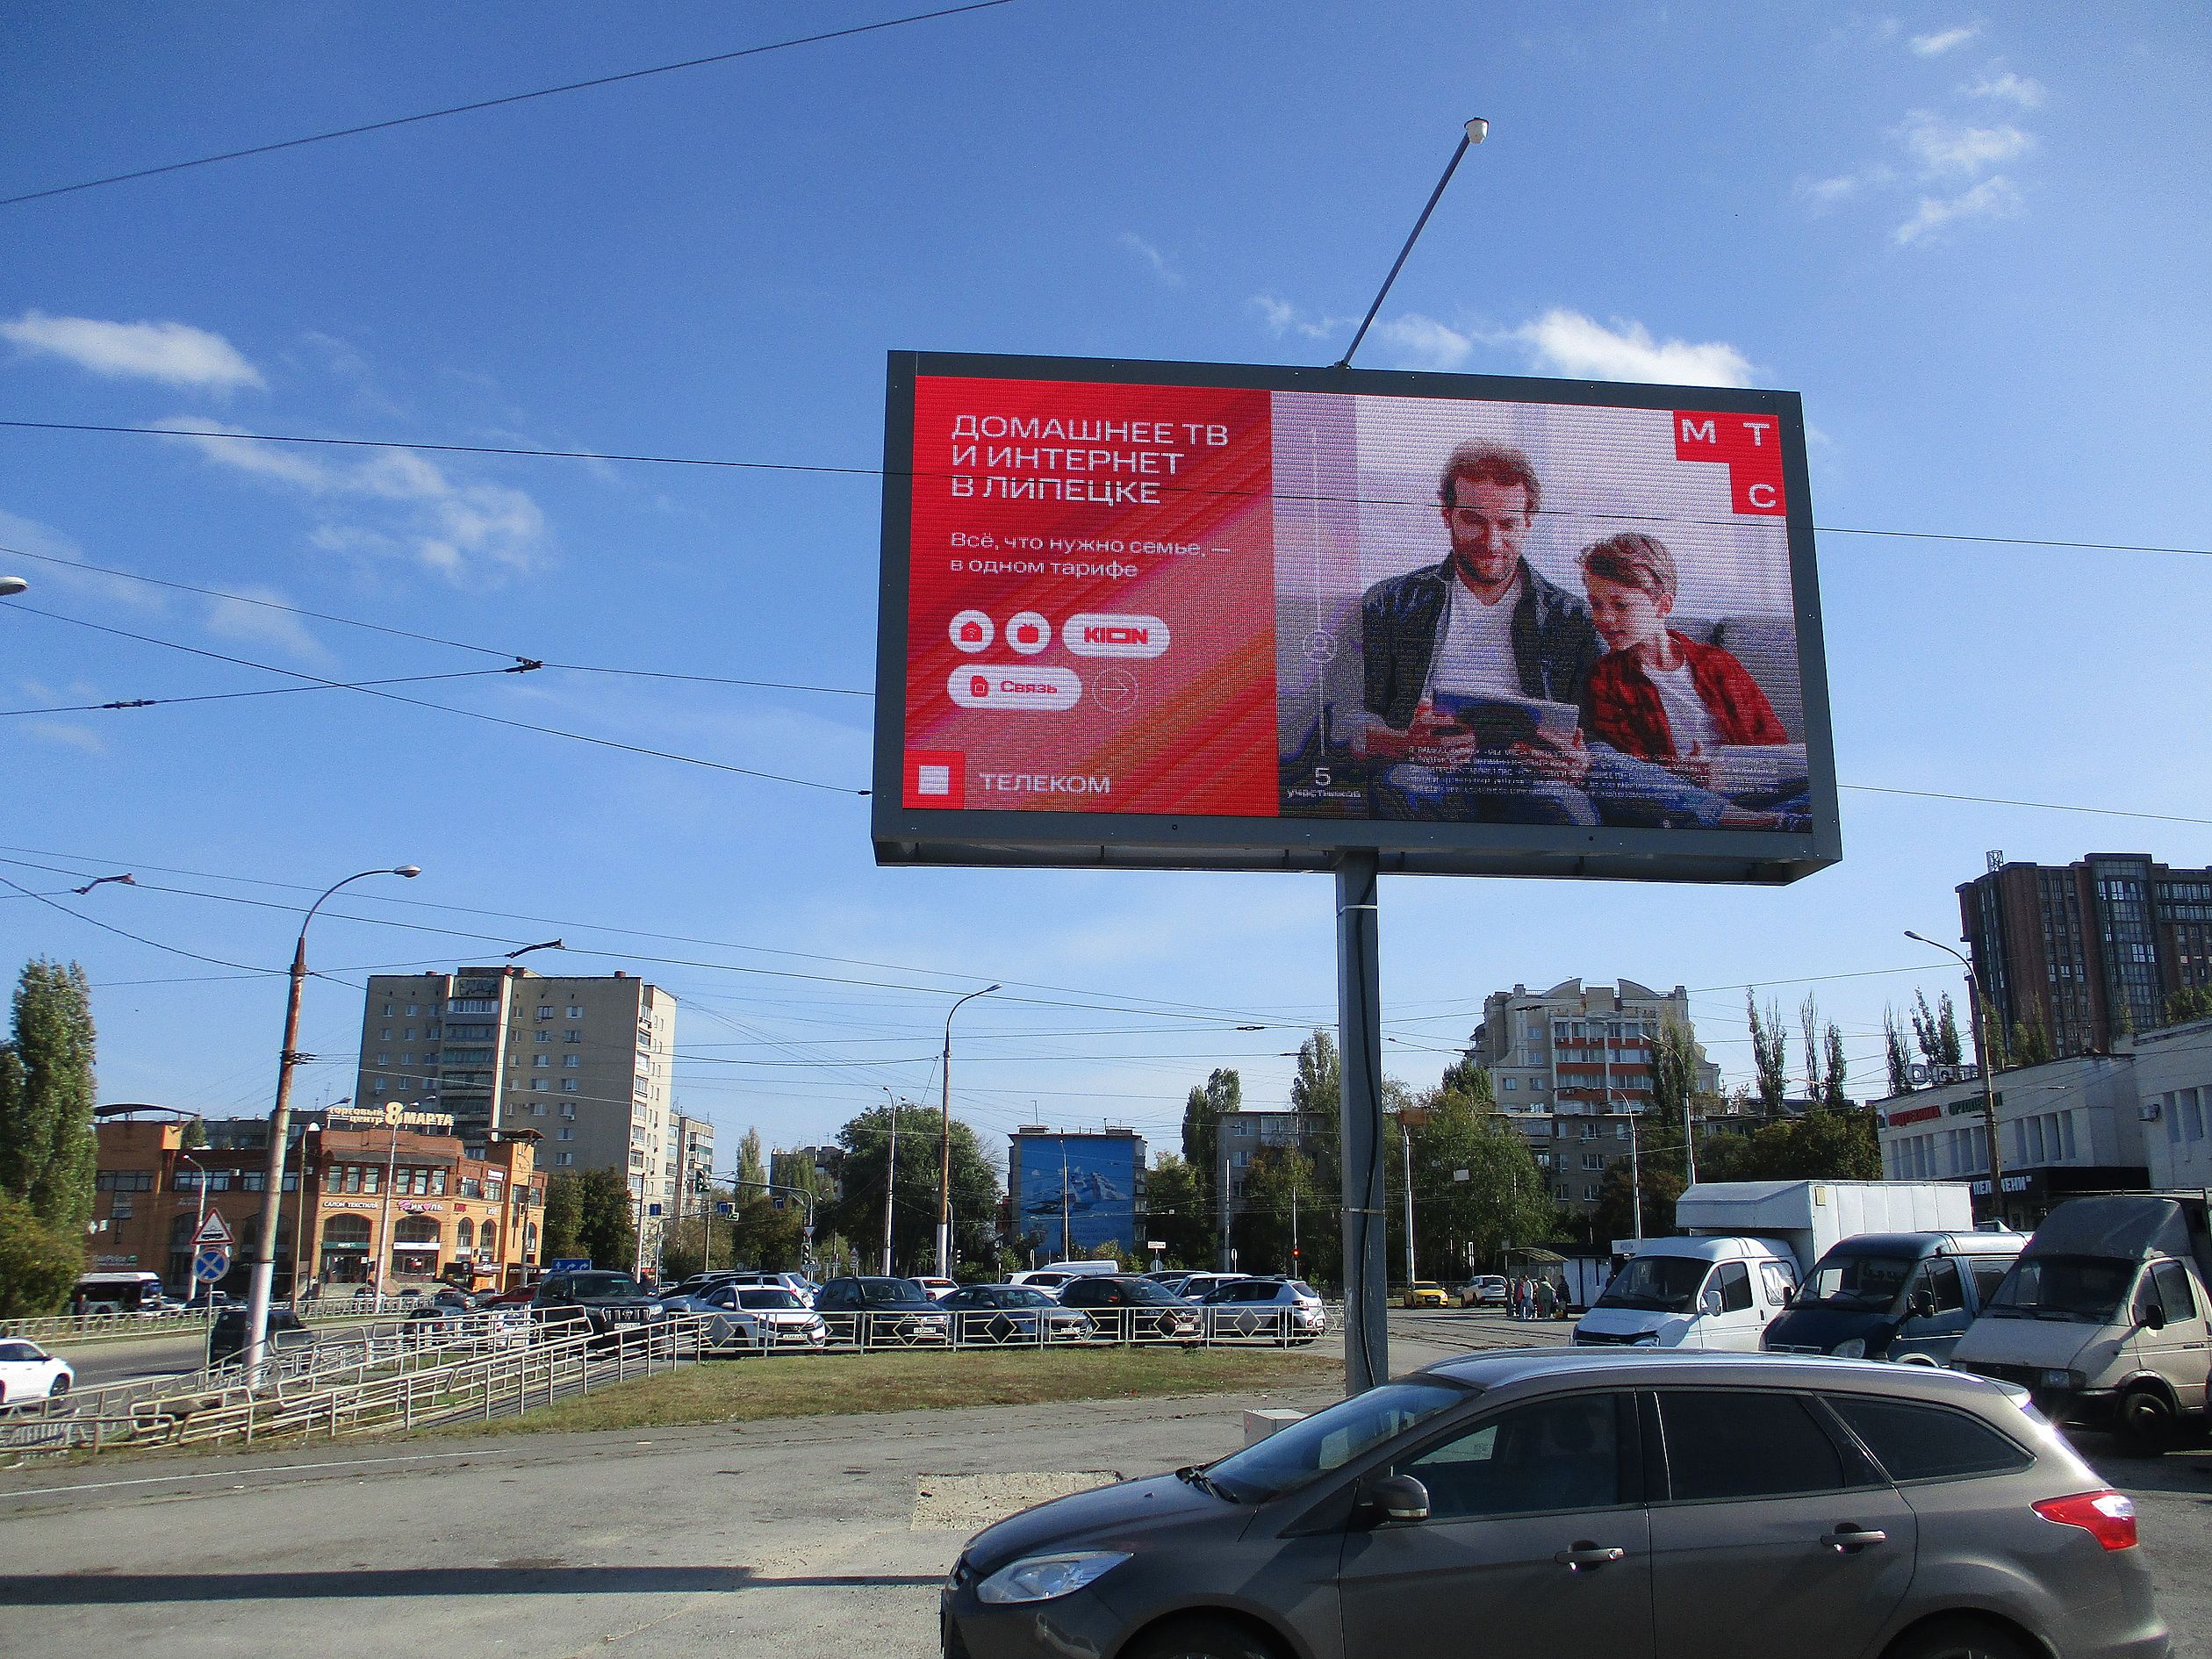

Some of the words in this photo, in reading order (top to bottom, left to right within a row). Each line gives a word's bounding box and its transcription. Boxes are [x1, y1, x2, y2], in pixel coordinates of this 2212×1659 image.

[951, 414, 1174, 445] ДОМАШНЕЕ
[1181, 423, 1229, 447] ТВ
[952, 444, 977, 467] И
[987, 445, 1186, 475] ИНТЕРНЕТ
[952, 475, 974, 498] В
[981, 475, 1161, 506] ЛИПЕЦКЕ
[951, 531, 1000, 550] Всё,
[1003, 536, 1044, 550] что
[1050, 537, 1124, 553] нужно
[1130, 539, 1207, 558] семье,
[950, 561, 964, 571] в
[968, 561, 1045, 576] одном
[1050, 562, 1138, 581] тарифе
[1083, 626, 1149, 645] KION
[1000, 679, 1058, 694] Связь
[979, 772, 1111, 794] ТЕЛЕКОМ
[1315, 767, 1331, 786] 5
[384, 1102, 403, 1126] 8
[404, 1111, 455, 1126] МАРТА
